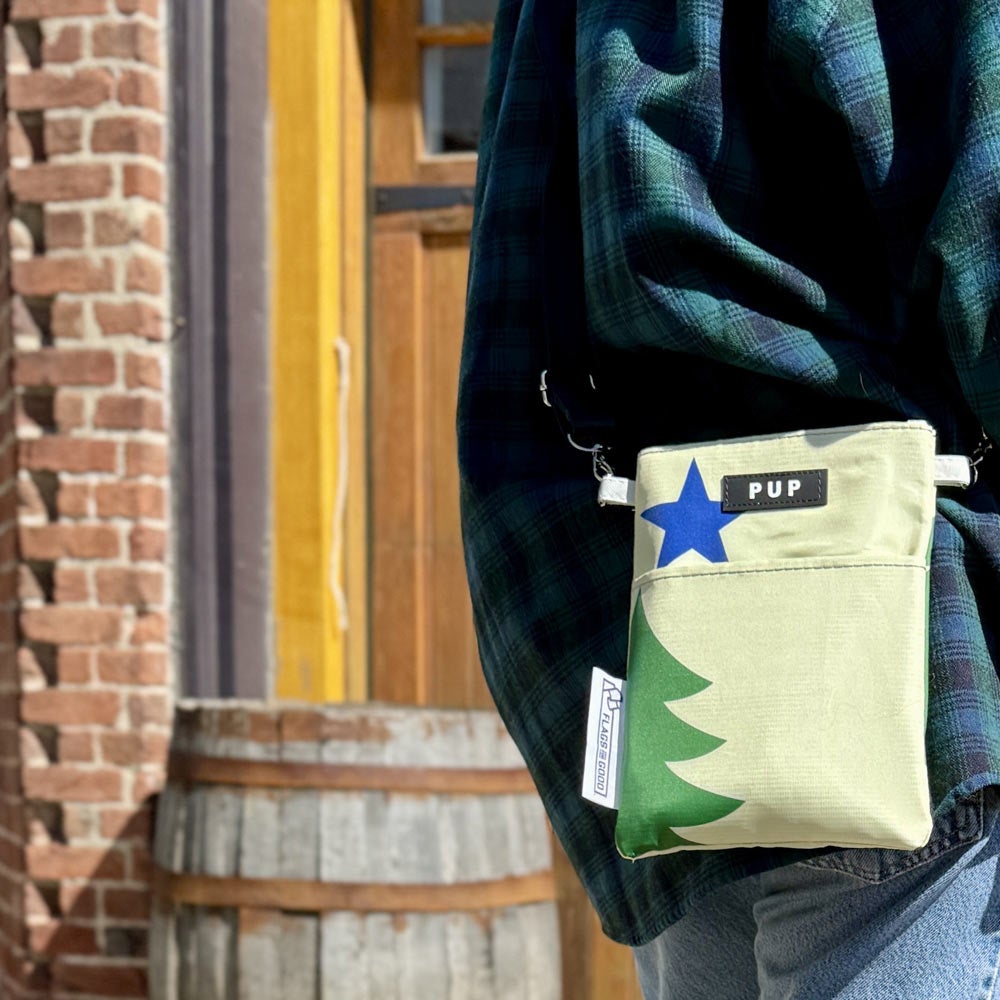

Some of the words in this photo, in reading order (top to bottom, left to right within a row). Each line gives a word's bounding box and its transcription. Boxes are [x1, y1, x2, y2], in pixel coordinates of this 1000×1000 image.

[749, 479, 801, 500] PUP
[600, 712, 610, 750] FLAGS
[597, 760, 606, 791] GOOD
